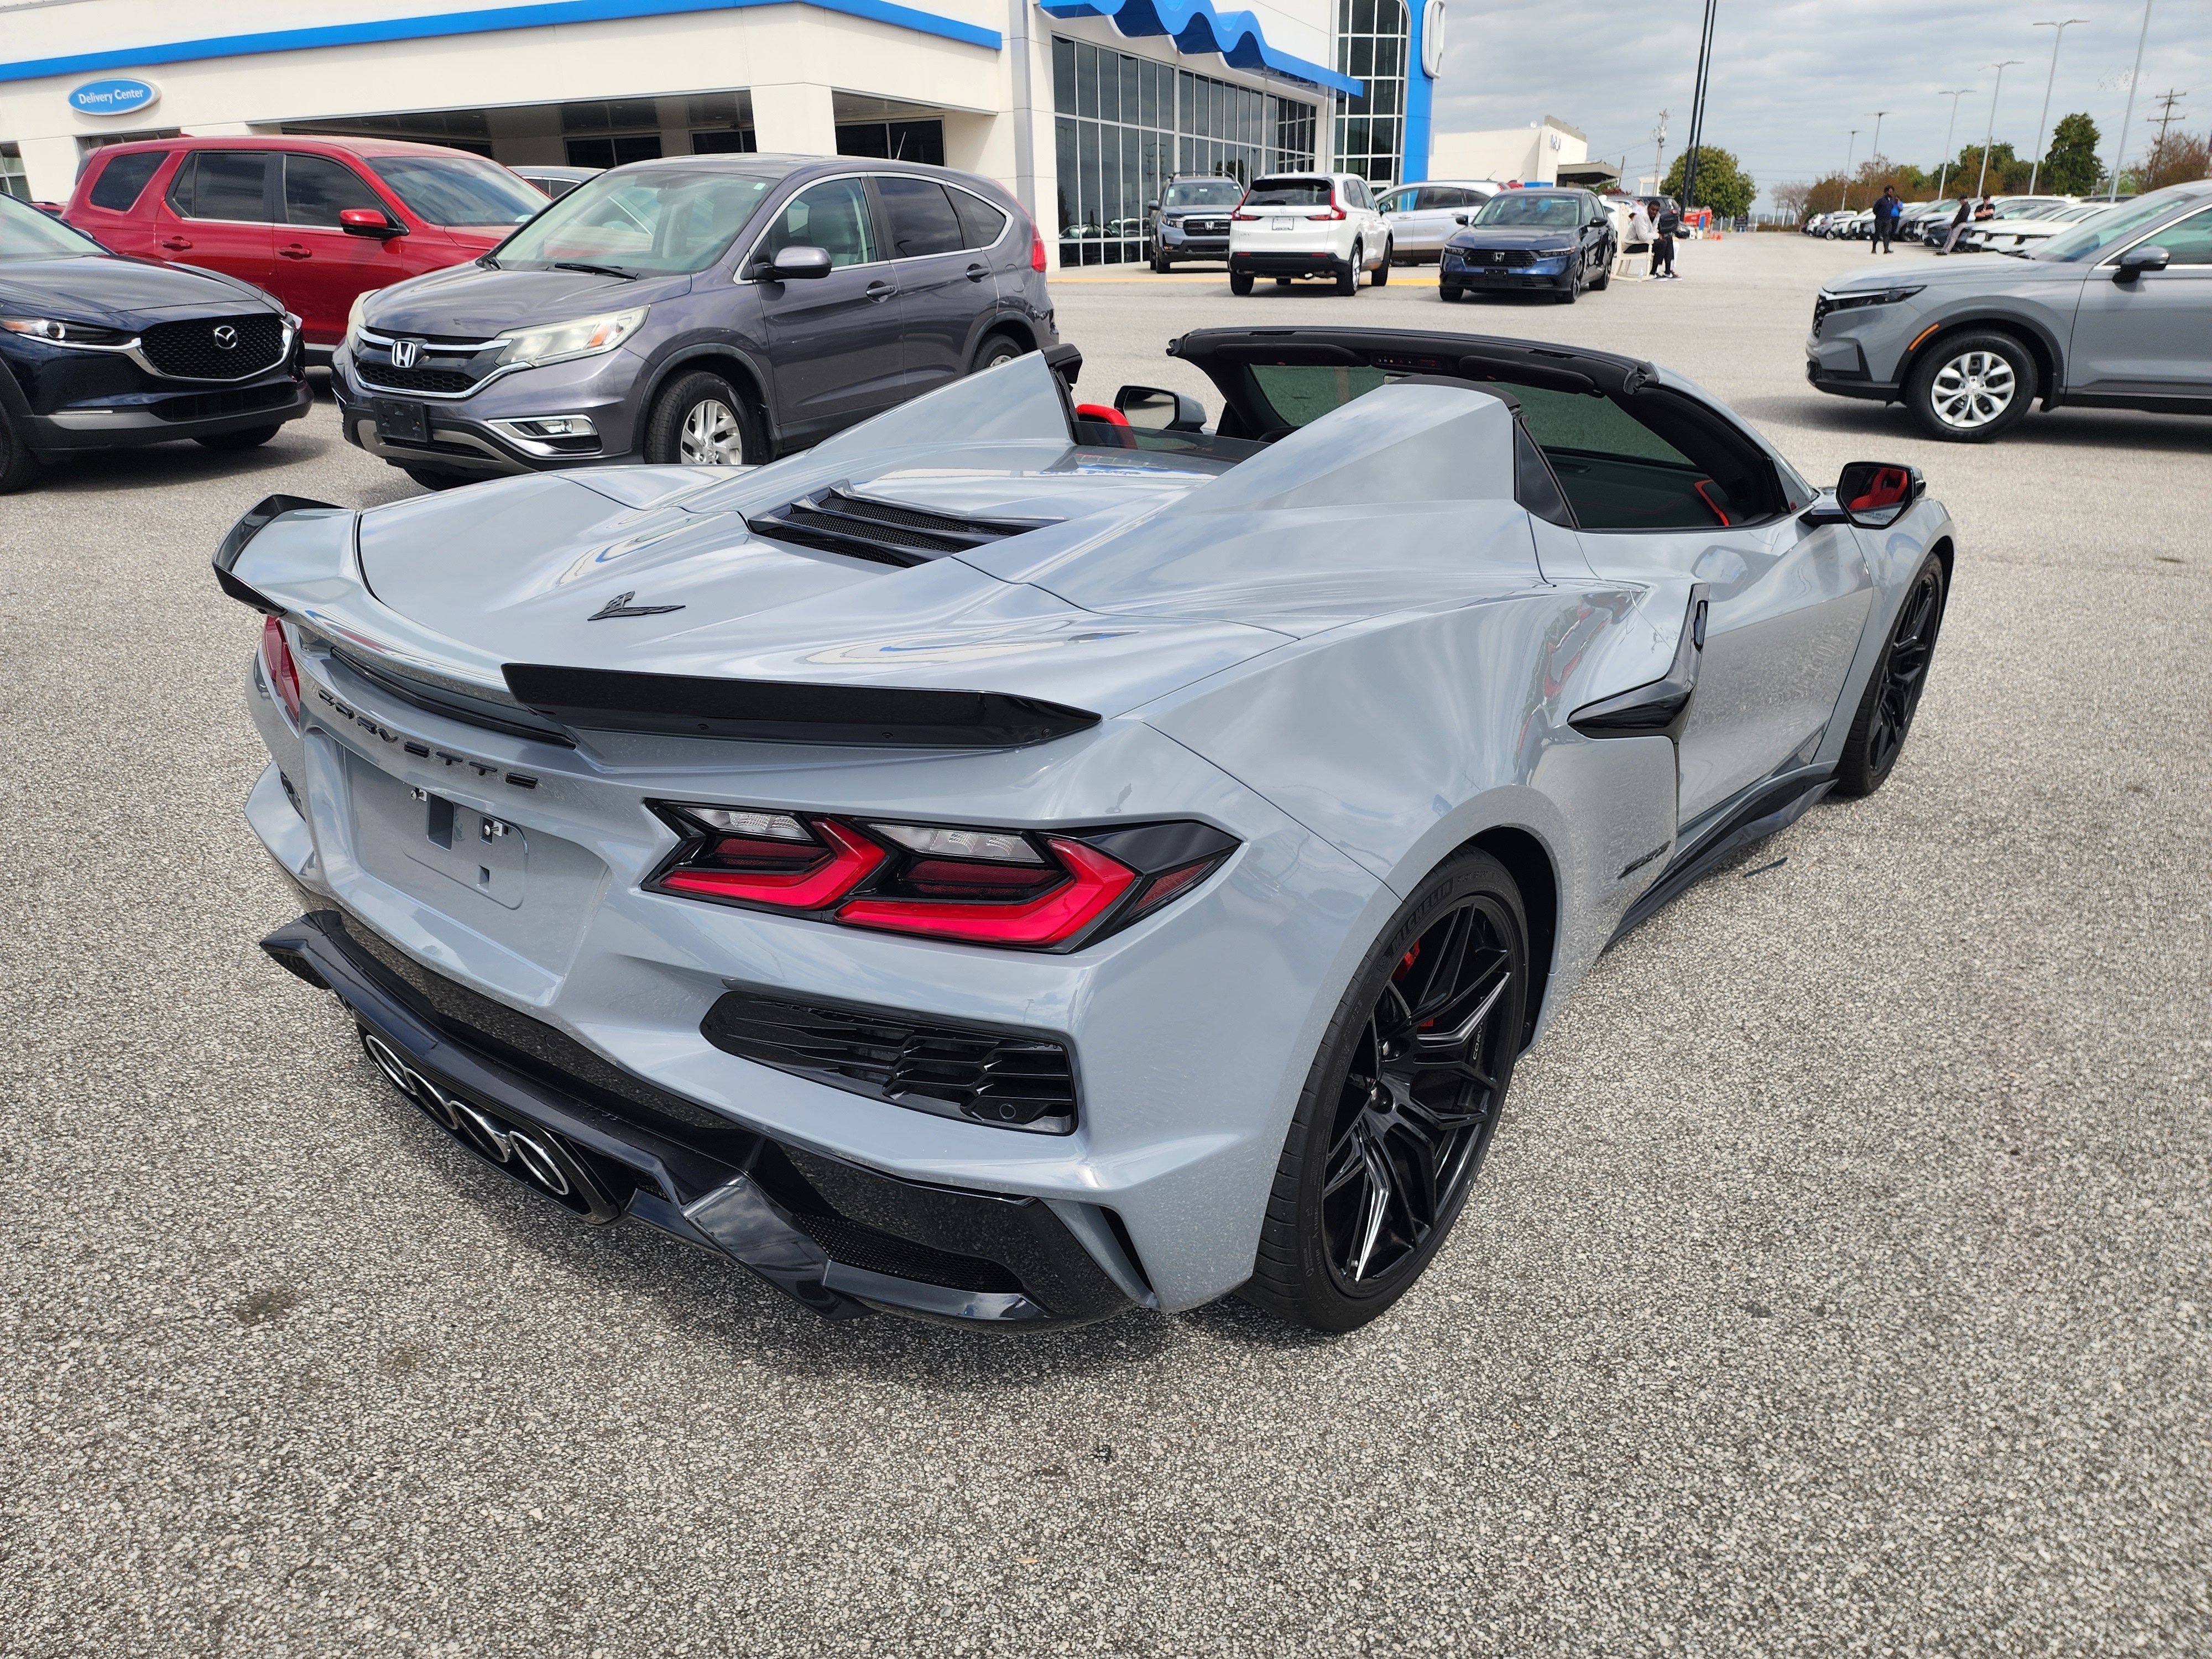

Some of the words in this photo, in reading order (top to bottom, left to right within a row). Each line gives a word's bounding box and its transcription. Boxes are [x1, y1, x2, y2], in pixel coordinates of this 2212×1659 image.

[78, 92, 113, 105] Delivery
[114, 89, 144, 100] Center
[319, 689, 539, 790] CORVETTE
[1391, 879, 1453, 953] MICHELIN
